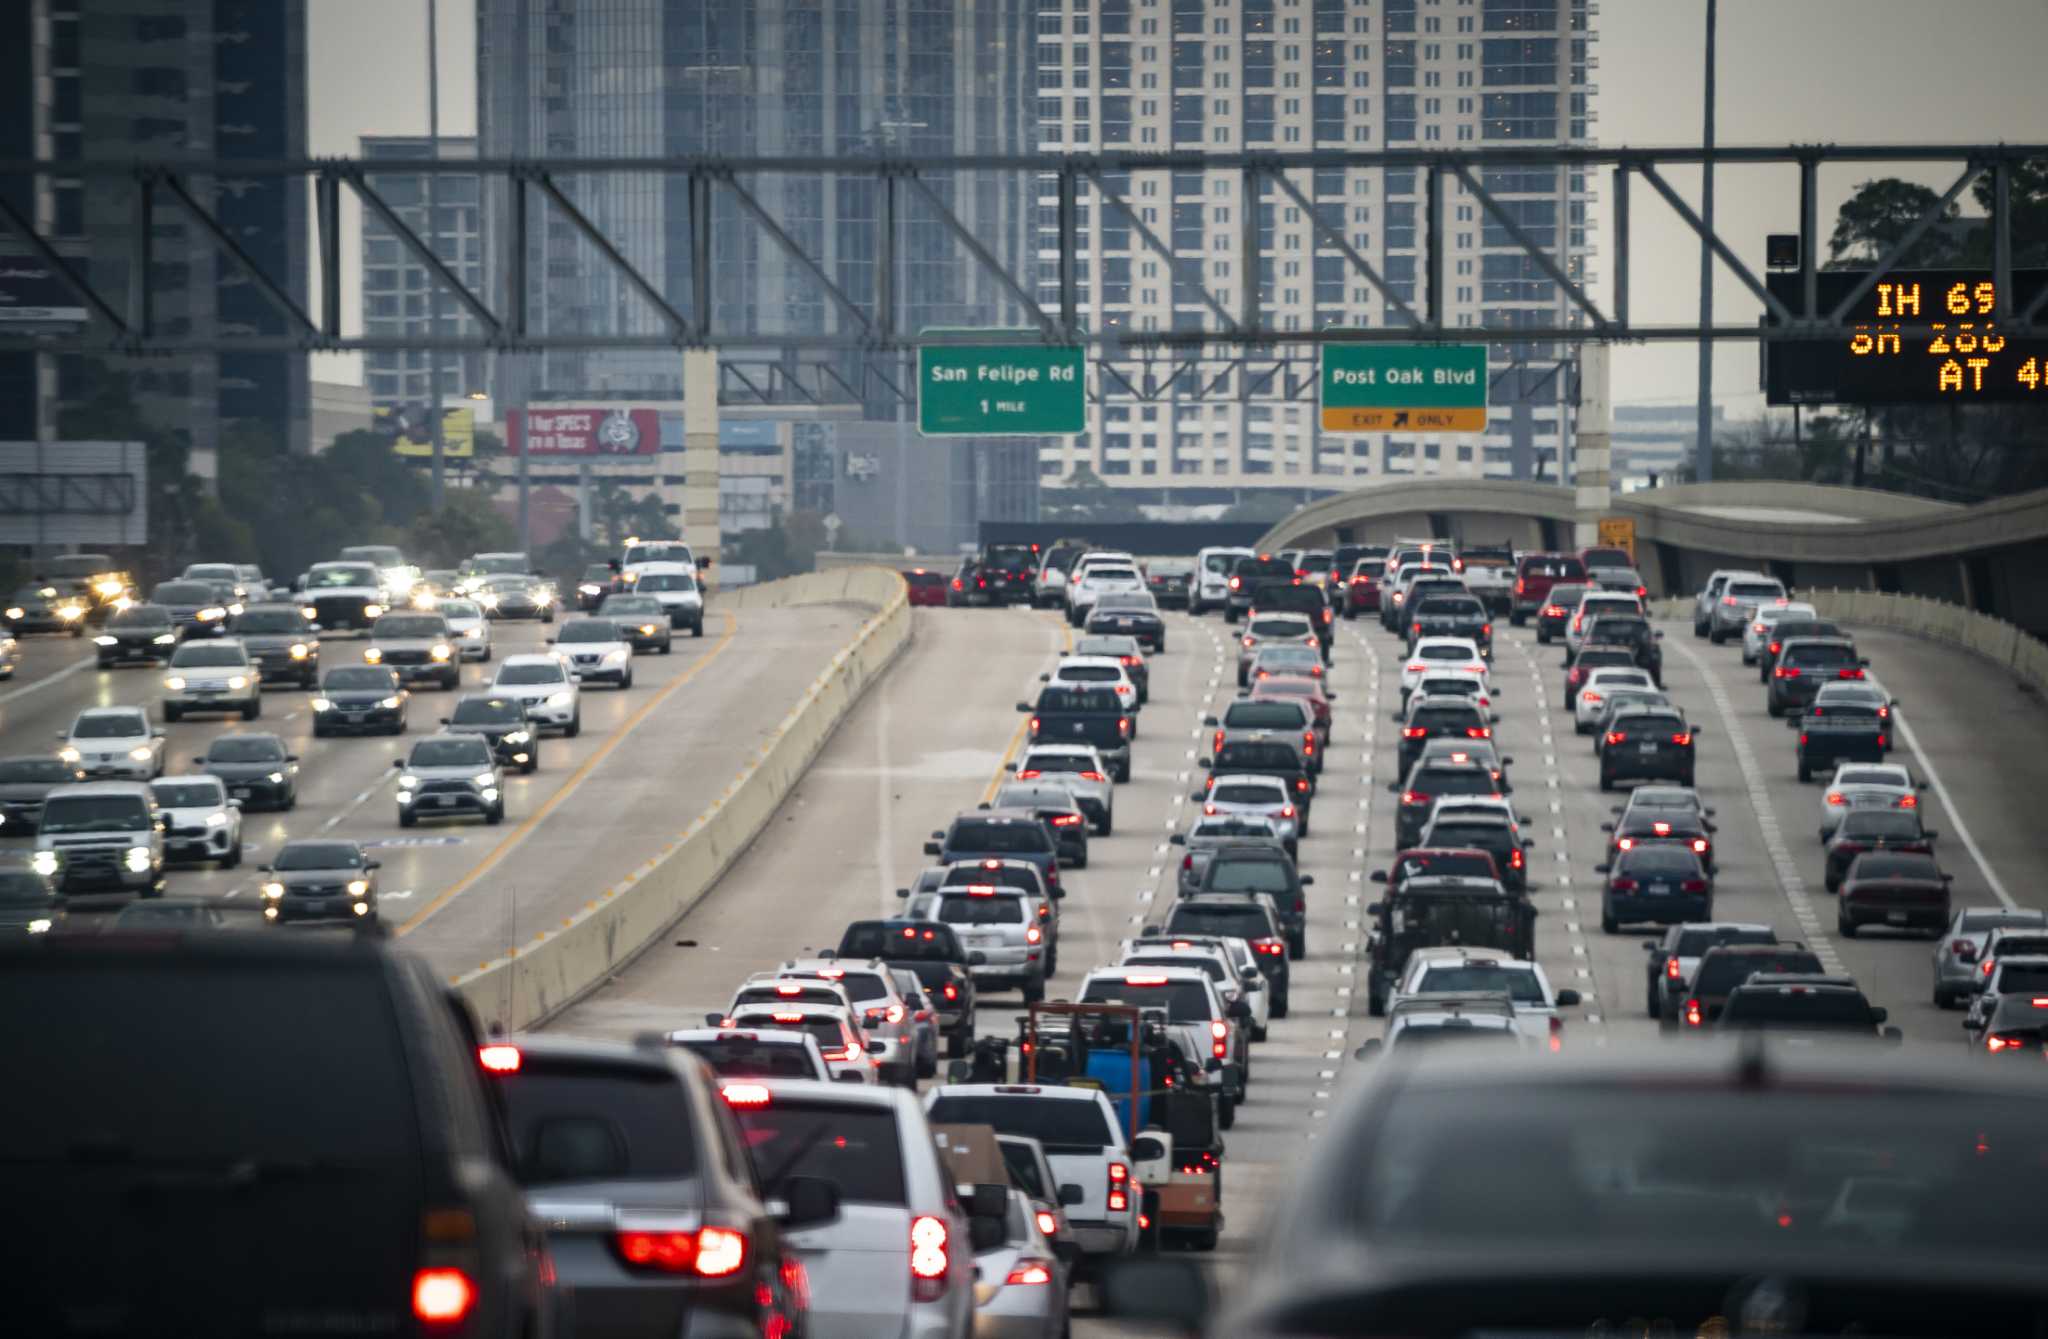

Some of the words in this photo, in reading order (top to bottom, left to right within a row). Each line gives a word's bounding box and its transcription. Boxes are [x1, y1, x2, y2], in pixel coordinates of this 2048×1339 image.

[1877, 283, 1920, 315] IH
[1946, 282, 1995, 314] 69
[931, 365, 968, 382] San
[978, 365, 1040, 385] Felipe
[1049, 365, 1075, 382] Rd
[1332, 368, 1376, 384] Post
[1385, 368, 1424, 384] Oak
[1433, 368, 1476, 384] Blvd
[1938, 358, 1990, 391] AT
[2017, 357, 2048, 390] 4
[980, 399, 989, 414] 1
[996, 401, 1025, 413] MILE
[1352, 415, 1383, 426] EXIT
[1416, 415, 1454, 426] ONLY
